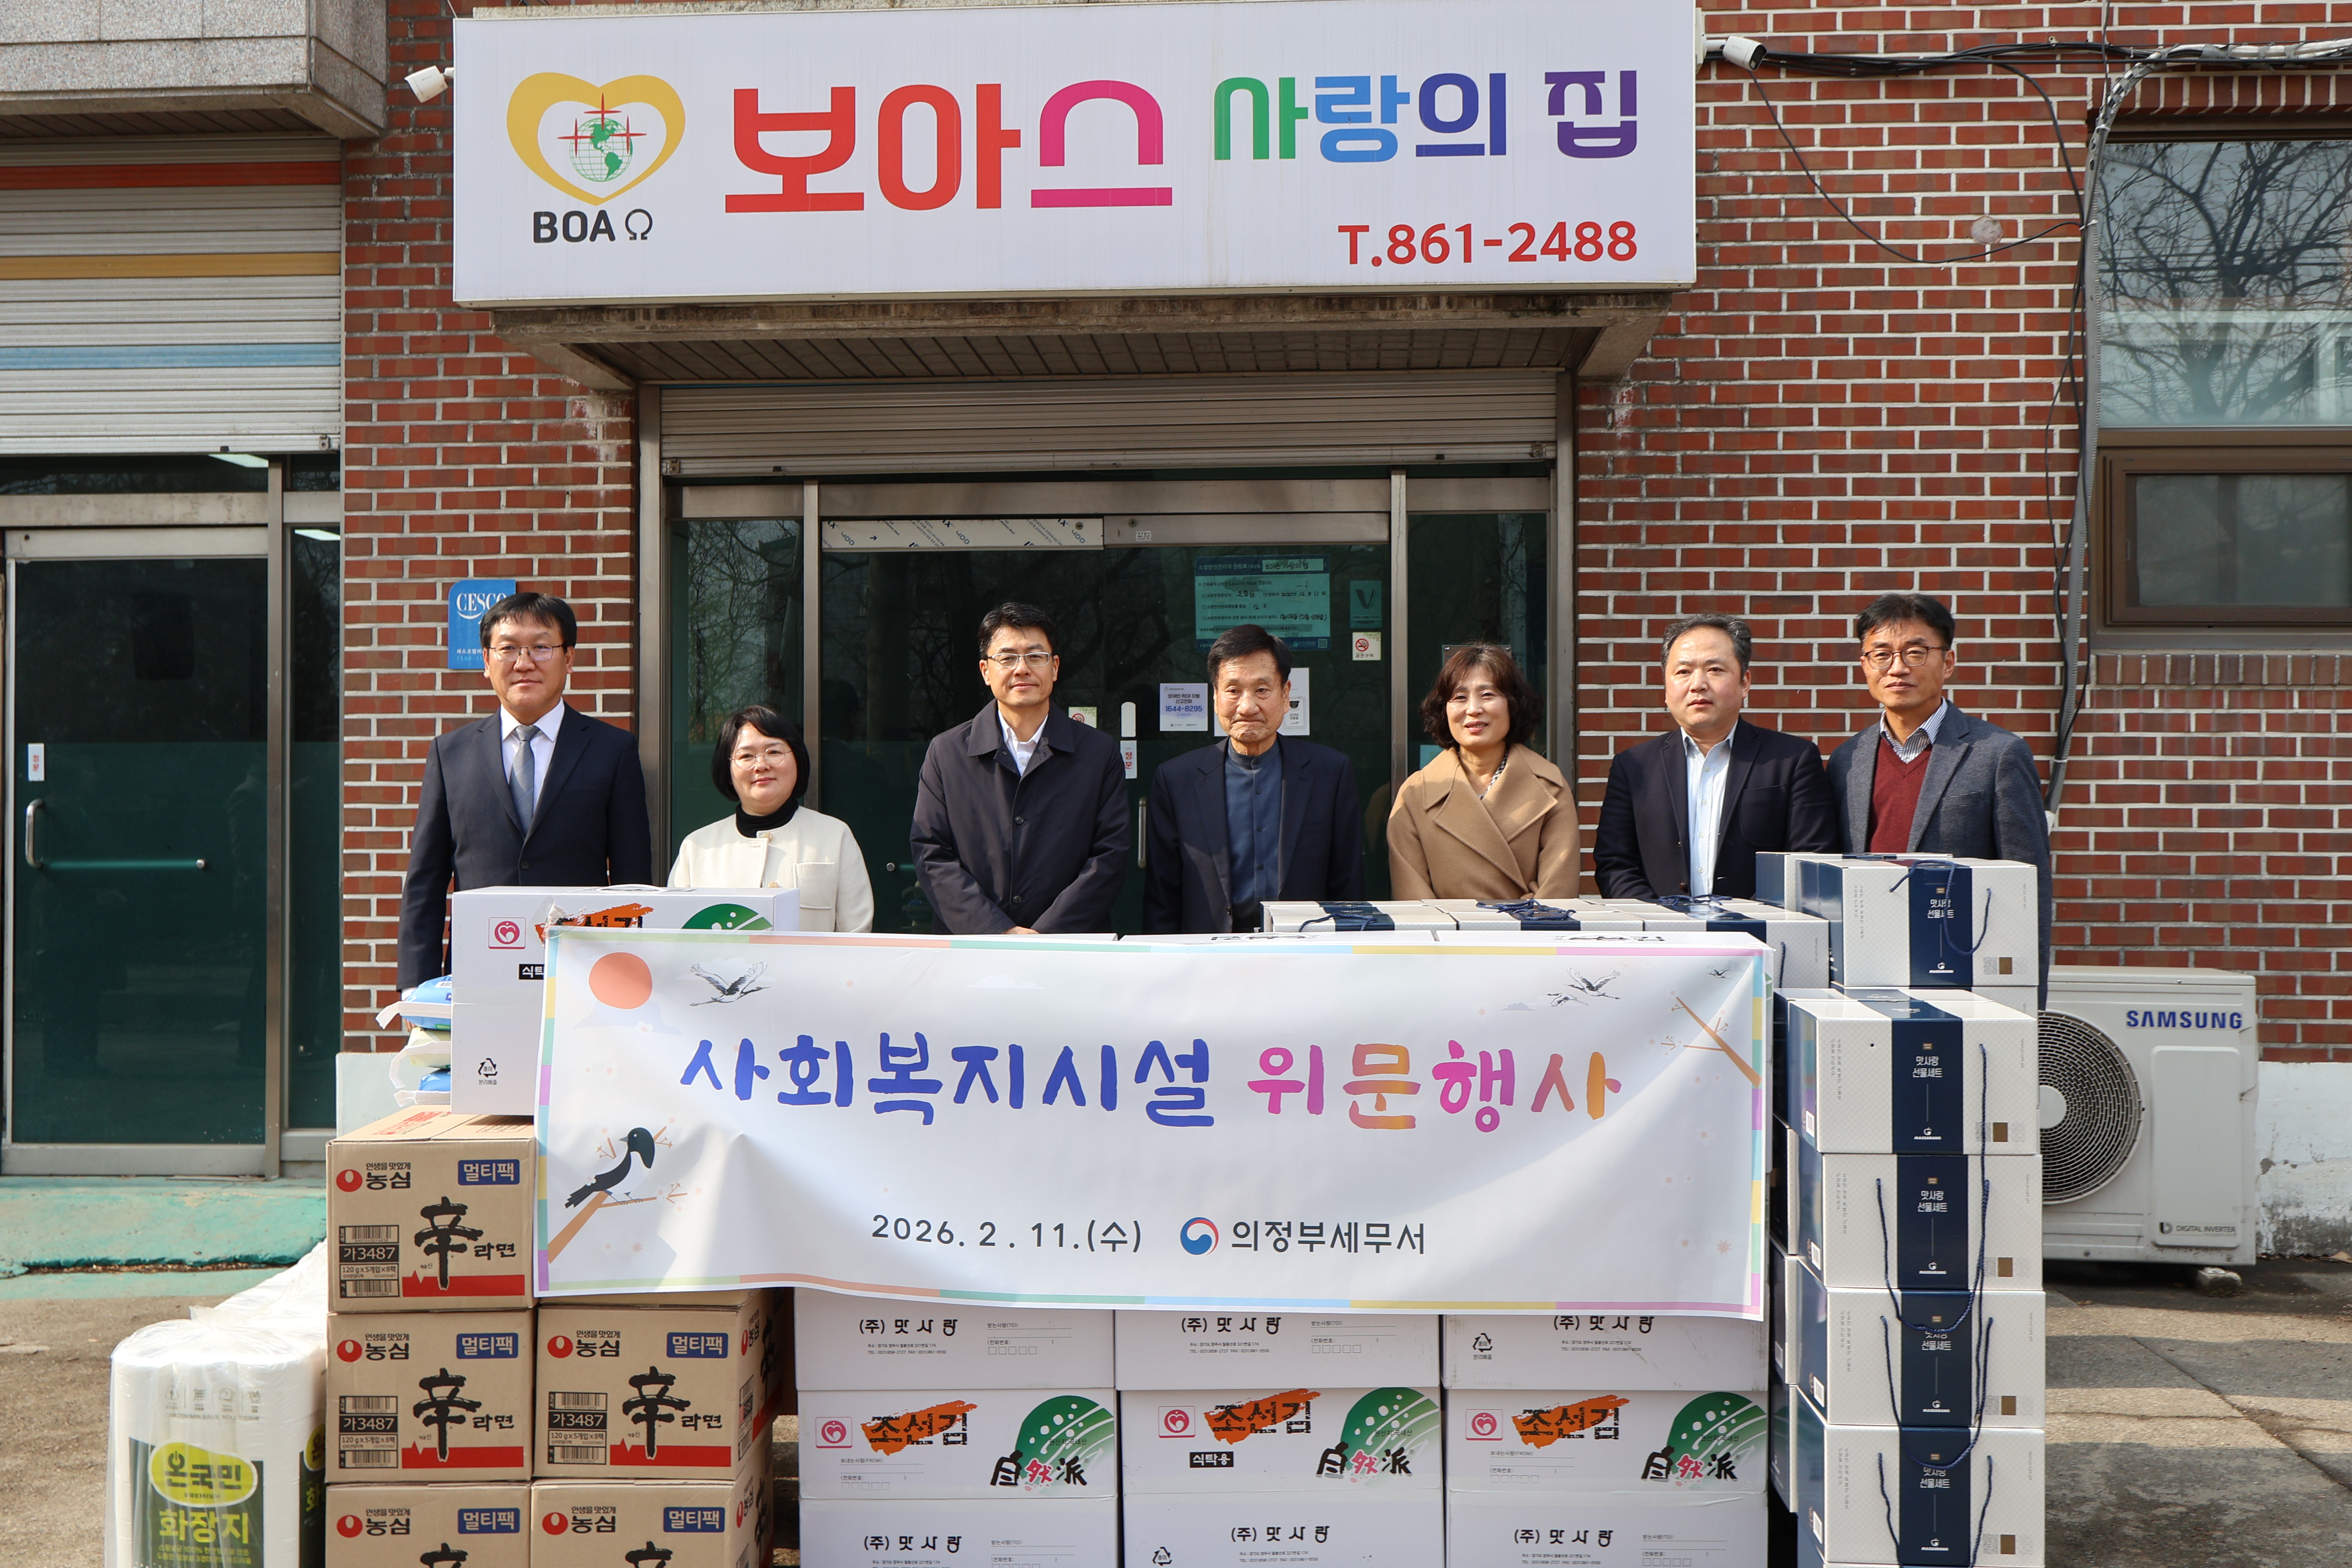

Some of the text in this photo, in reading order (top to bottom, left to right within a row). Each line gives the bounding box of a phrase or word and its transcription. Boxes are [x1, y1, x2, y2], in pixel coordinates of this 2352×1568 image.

[725, 71, 1637, 213] 보아스 사랑의 집
[534, 210, 615, 243] BOA
[1338, 221, 1637, 266] T.861-2488
[2127, 1011, 2241, 1029] SAMSUNG
[1916, 1056, 1939, 1066] 맛사랑
[1912, 1068, 1943, 1078] 선물세트
[681, 1033, 1622, 1132] 사회복지시설 위문행사
[389, 1162, 410, 1172] 맛있게
[464, 1163, 514, 1181] 멀티팩
[366, 1172, 410, 1190] 농심
[1921, 1191, 1944, 1201] 맛사랑
[1917, 1202, 1948, 1212] 선물세트
[414, 1196, 483, 1289] 辛
[872, 1215, 964, 1246] 2026.
[1031, 1220, 1140, 1252] 11.(수)
[1232, 1221, 1423, 1253] 의정부세무서
[344, 1247, 395, 1261] 가3487
[474, 1243, 516, 1260] 라면
[860, 1319, 884, 1334] (주)
[1182, 1318, 1207, 1332] (주)
[1554, 1316, 1579, 1330] (주)
[365, 1343, 409, 1361] 농심
[462, 1336, 513, 1356] 멀티팩
[576, 1339, 619, 1357] 농심
[671, 1336, 723, 1355] 멀티팩
[1921, 1341, 1952, 1351] 선물세트
[413, 1367, 482, 1460] 辛
[553, 1413, 604, 1427] 가3487
[622, 1366, 691, 1458] 辛
[1212, 1401, 1311, 1434] 조선김
[344, 1417, 394, 1431] 가3487
[473, 1414, 514, 1432] 라면
[681, 1414, 722, 1431] 라면
[870, 1412, 967, 1445] 조선김
[1520, 1407, 1620, 1440] 조선김
[1192, 1454, 1231, 1466] 식탁용
[165, 1451, 241, 1490] 온국민
[1920, 1479, 1950, 1488] 선물세트
[160, 1509, 249, 1544] 화장지
[366, 1518, 410, 1536] 농심
[463, 1512, 514, 1530] 멀티팩
[571, 1515, 615, 1534] 농심
[669, 1510, 720, 1529] 멀티팩
[864, 1536, 889, 1550] (주)
[1232, 1528, 1256, 1542] (주)
[1515, 1530, 1539, 1544] (주)
